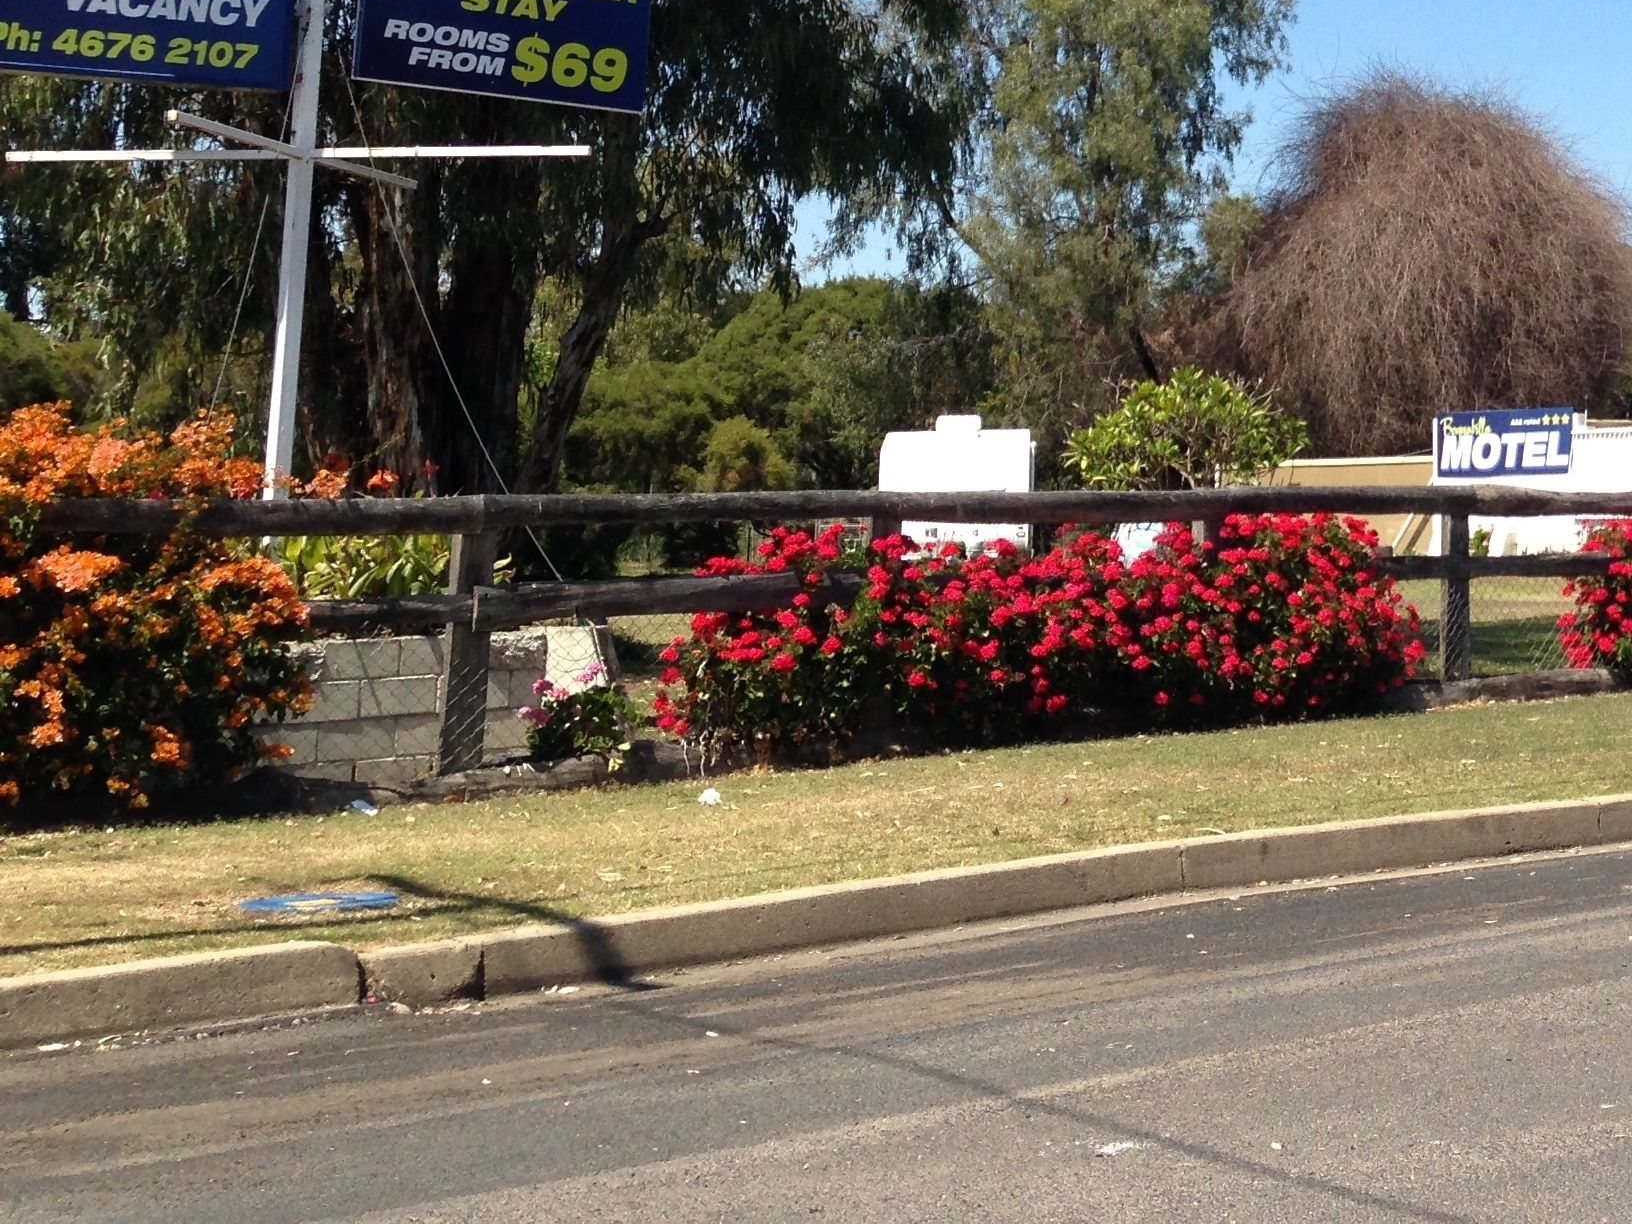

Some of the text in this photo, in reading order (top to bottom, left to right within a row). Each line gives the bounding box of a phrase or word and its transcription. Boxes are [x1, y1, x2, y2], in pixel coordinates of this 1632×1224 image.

[52, 29, 156, 61] 4676
[164, 37, 259, 69] 2107
[383, 19, 510, 53] ROOMS
[407, 46, 506, 76] FROM
[511, 32, 628, 92] $69
[1440, 431, 1569, 470] MOTEL
